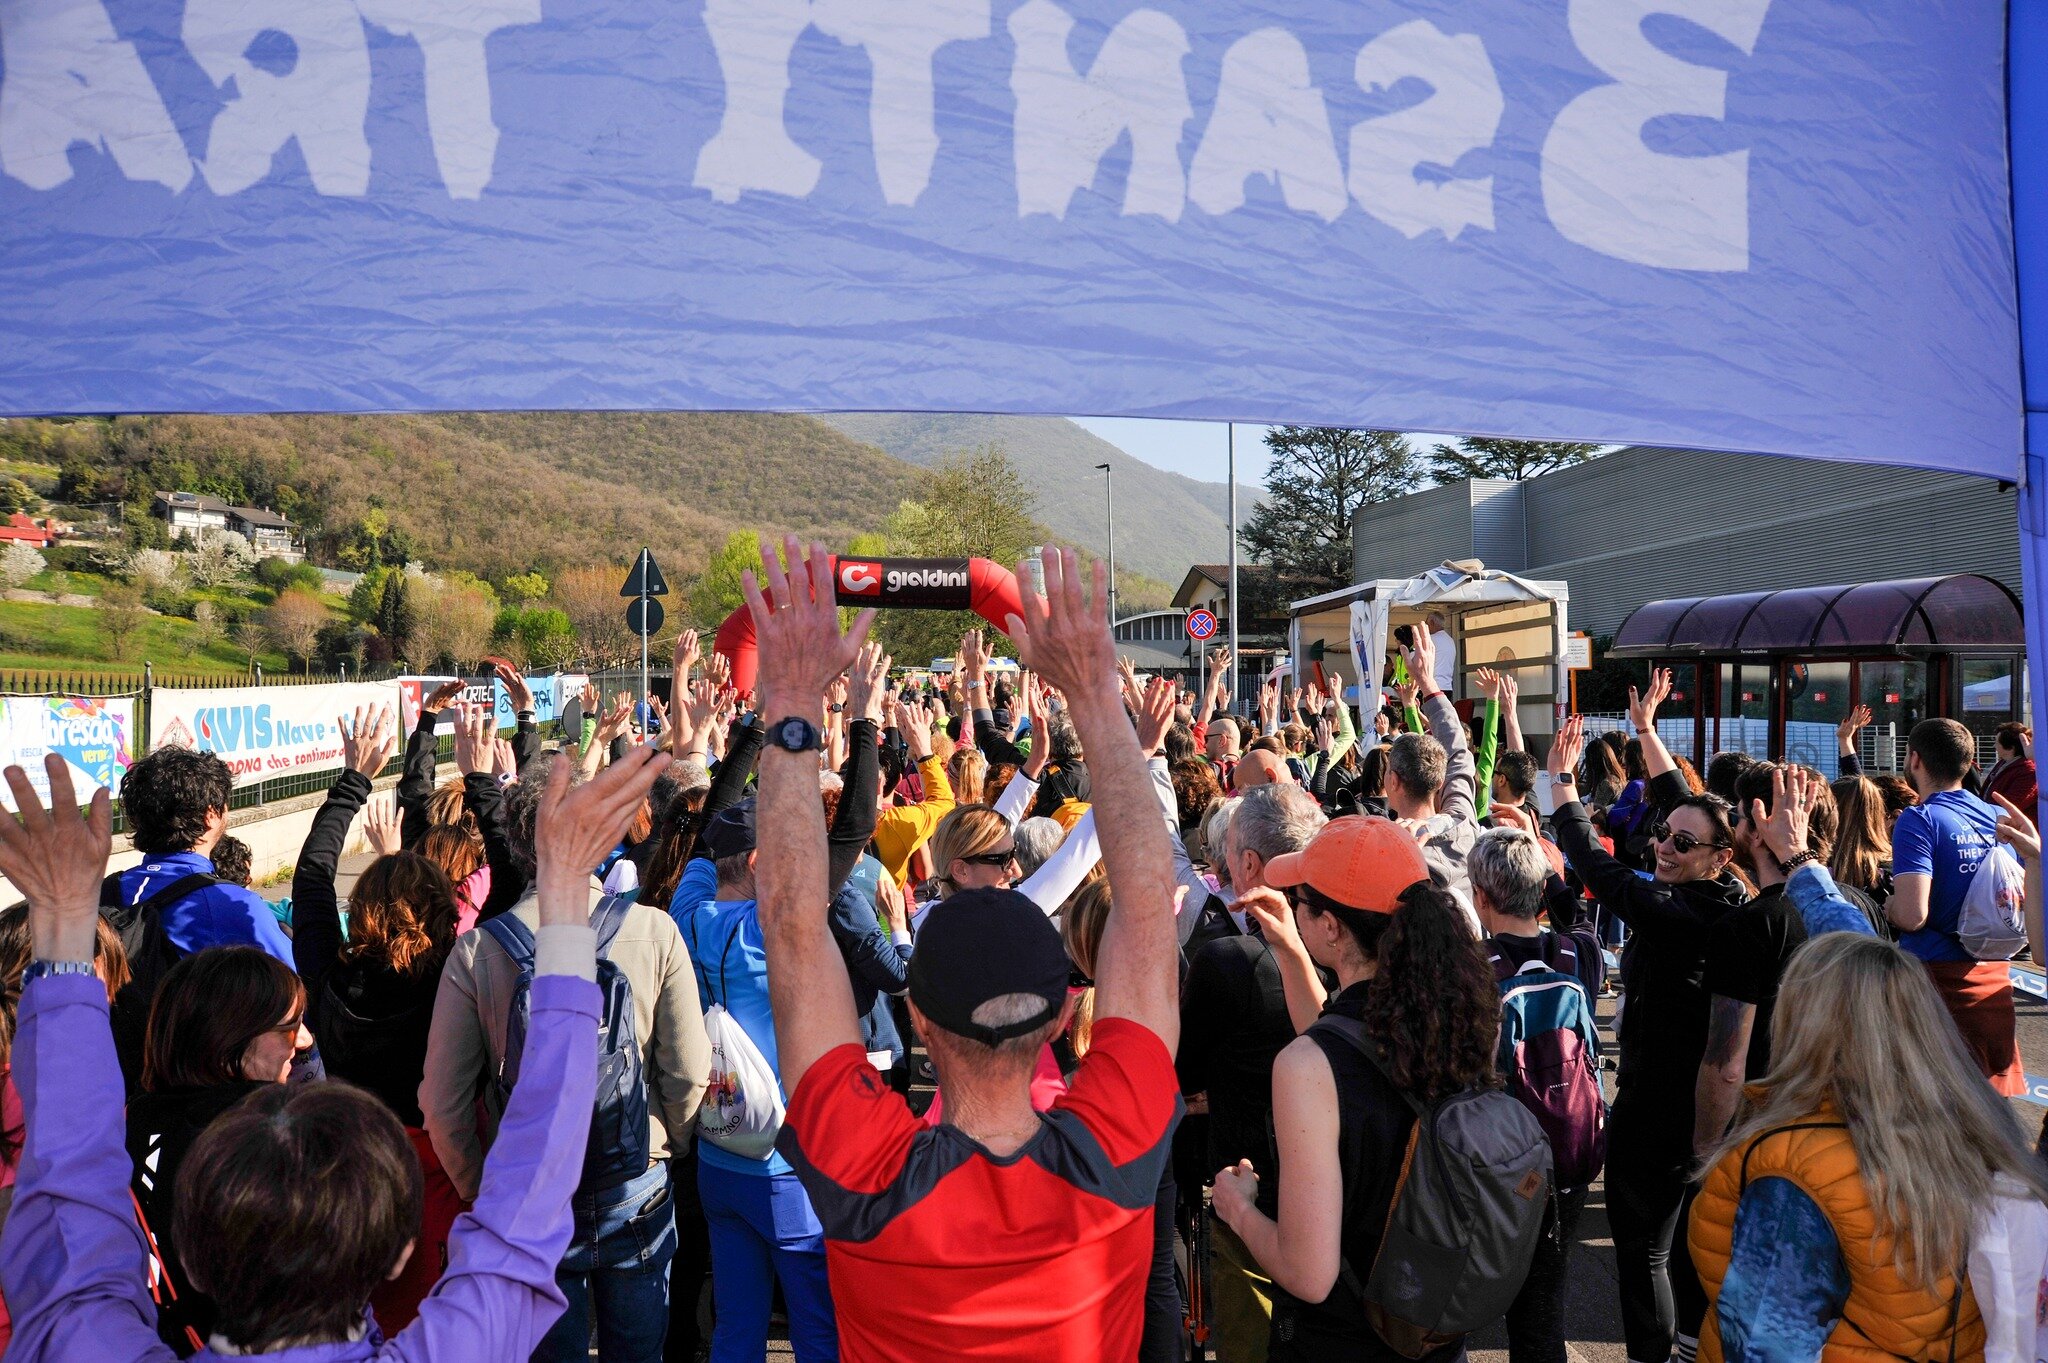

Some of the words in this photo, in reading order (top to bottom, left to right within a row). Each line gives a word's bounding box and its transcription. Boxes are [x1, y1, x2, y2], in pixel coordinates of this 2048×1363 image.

[887, 569, 967, 592] gialdini
[194, 704, 272, 752] AVIS
[277, 720, 325, 746] Nave
[267, 754, 290, 769] che
[295, 748, 336, 765] continua
[1957, 848, 1977, 859] THE
